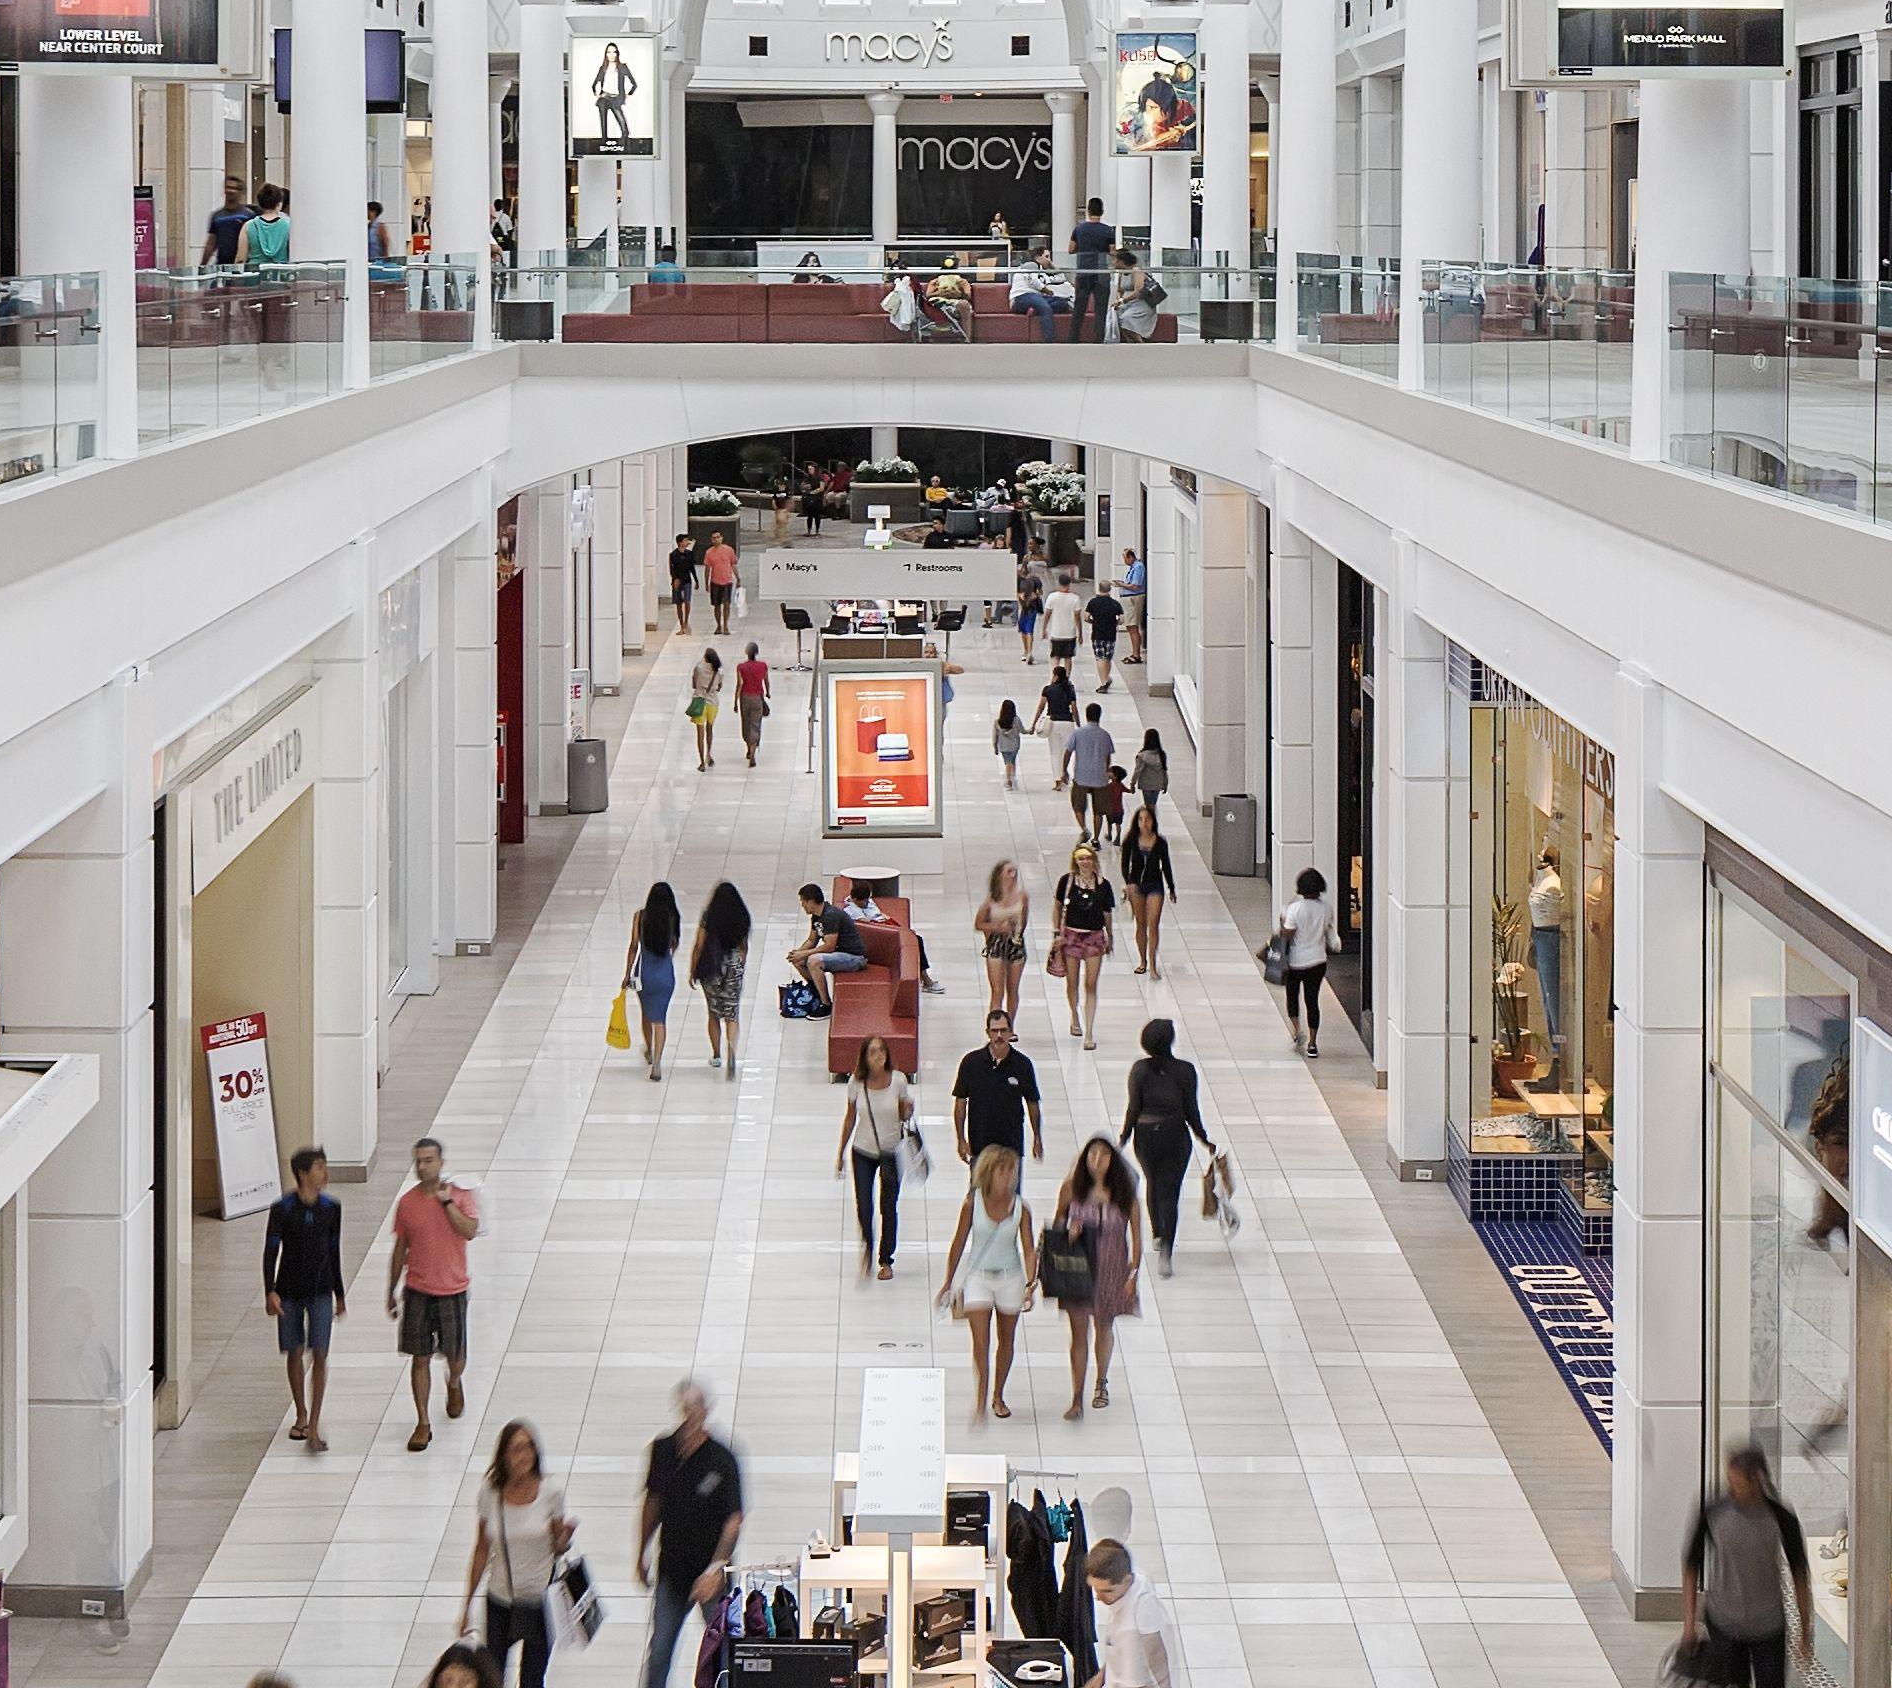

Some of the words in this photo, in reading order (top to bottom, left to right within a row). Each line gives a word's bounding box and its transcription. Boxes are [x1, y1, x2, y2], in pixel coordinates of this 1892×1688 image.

[60, 29, 102, 41] LOWER
[104, 30, 143, 42] LEVEL
[1623, 35, 1664, 43] MENLO
[1666, 35, 1696, 43] PARK
[1697, 35, 1727, 43] MALL
[39, 42, 72, 53] NEAR
[74, 42, 121, 54] CENTER
[124, 43, 164, 55] COURT
[825, 18, 954, 69] macy's
[898, 132, 1052, 179] macy's
[786, 563, 818, 572] Macy's
[916, 563, 963, 572] Restrooms
[214, 776, 244, 843] THE
[247, 728, 302, 813] LIMITED
